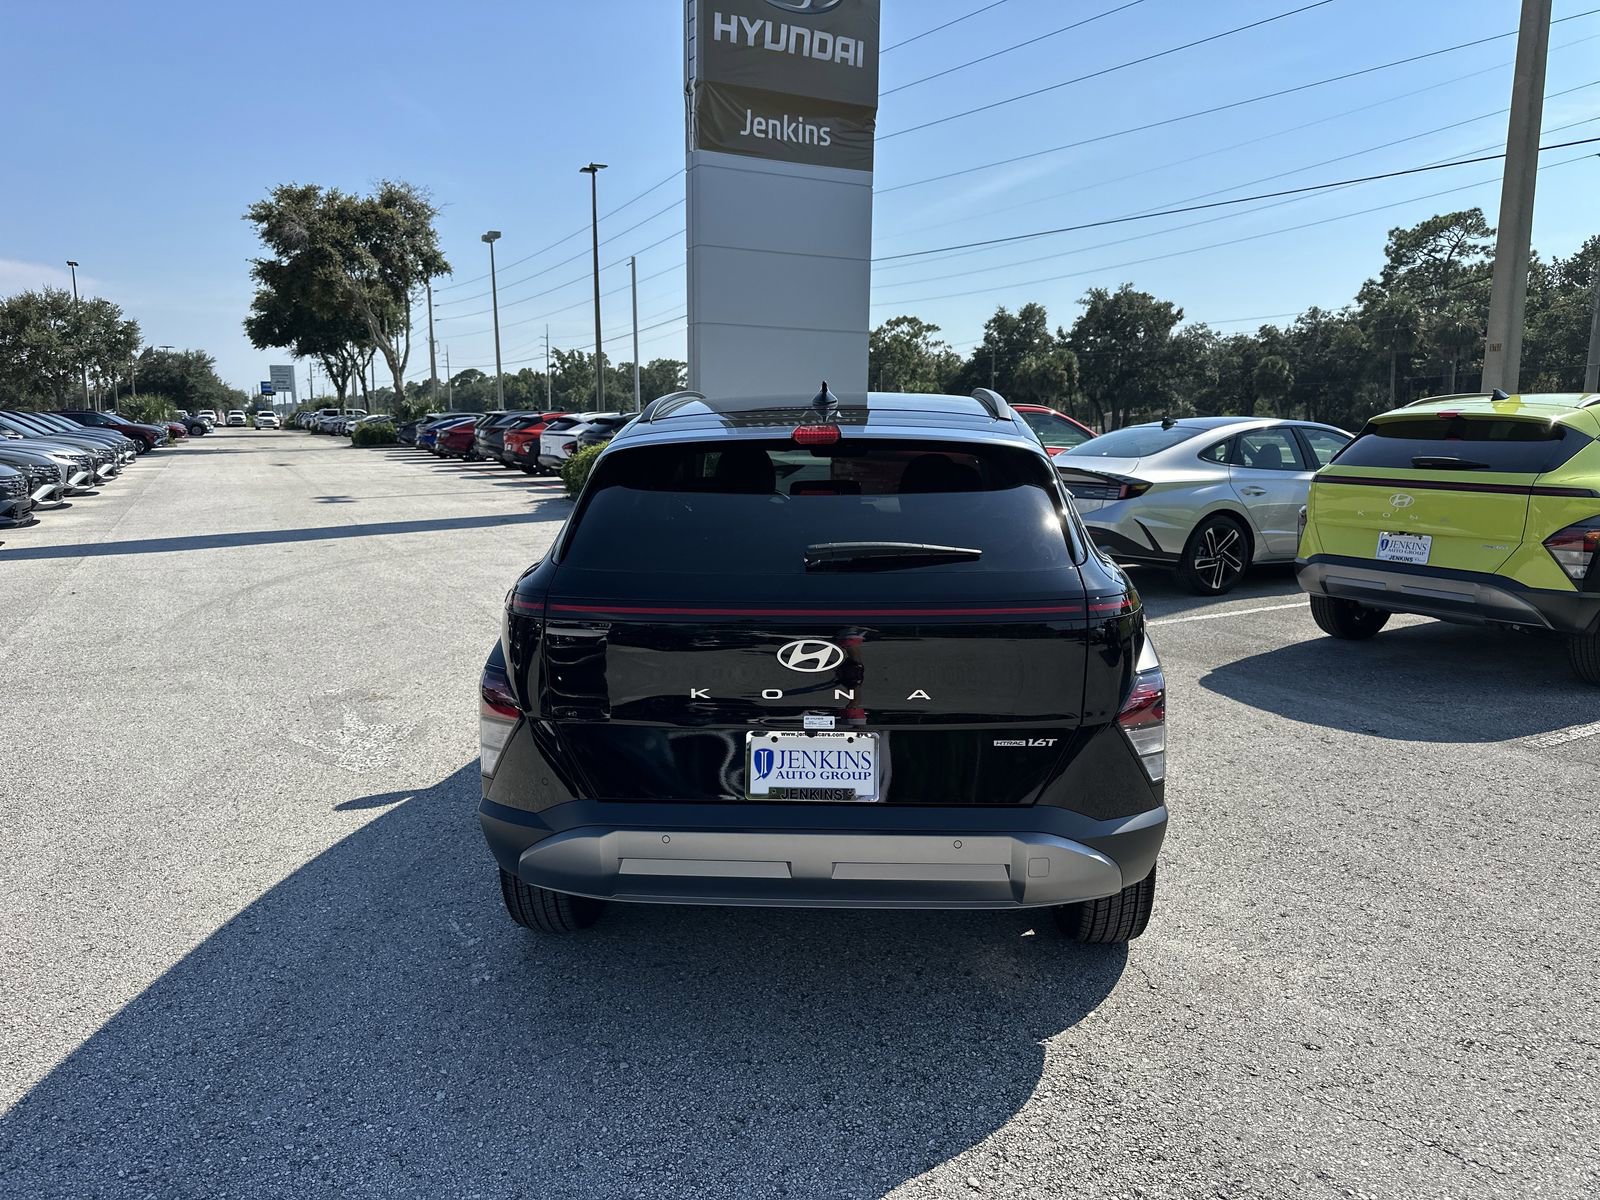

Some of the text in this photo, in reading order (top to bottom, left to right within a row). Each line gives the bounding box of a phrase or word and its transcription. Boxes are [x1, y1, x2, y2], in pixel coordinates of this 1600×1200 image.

[713, 11, 864, 68] HYUNDAI
[740, 109, 831, 146] Jenkins
[1389, 540, 1428, 552] JENKINS
[1388, 555, 1414, 563] JENKINS
[1404, 549, 1426, 557] GROUP
[690, 687, 932, 701] KONA
[775, 749, 872, 771] JENKINS
[775, 770, 872, 781] AUTO GROUP
[780, 788, 844, 801] JENKINS
